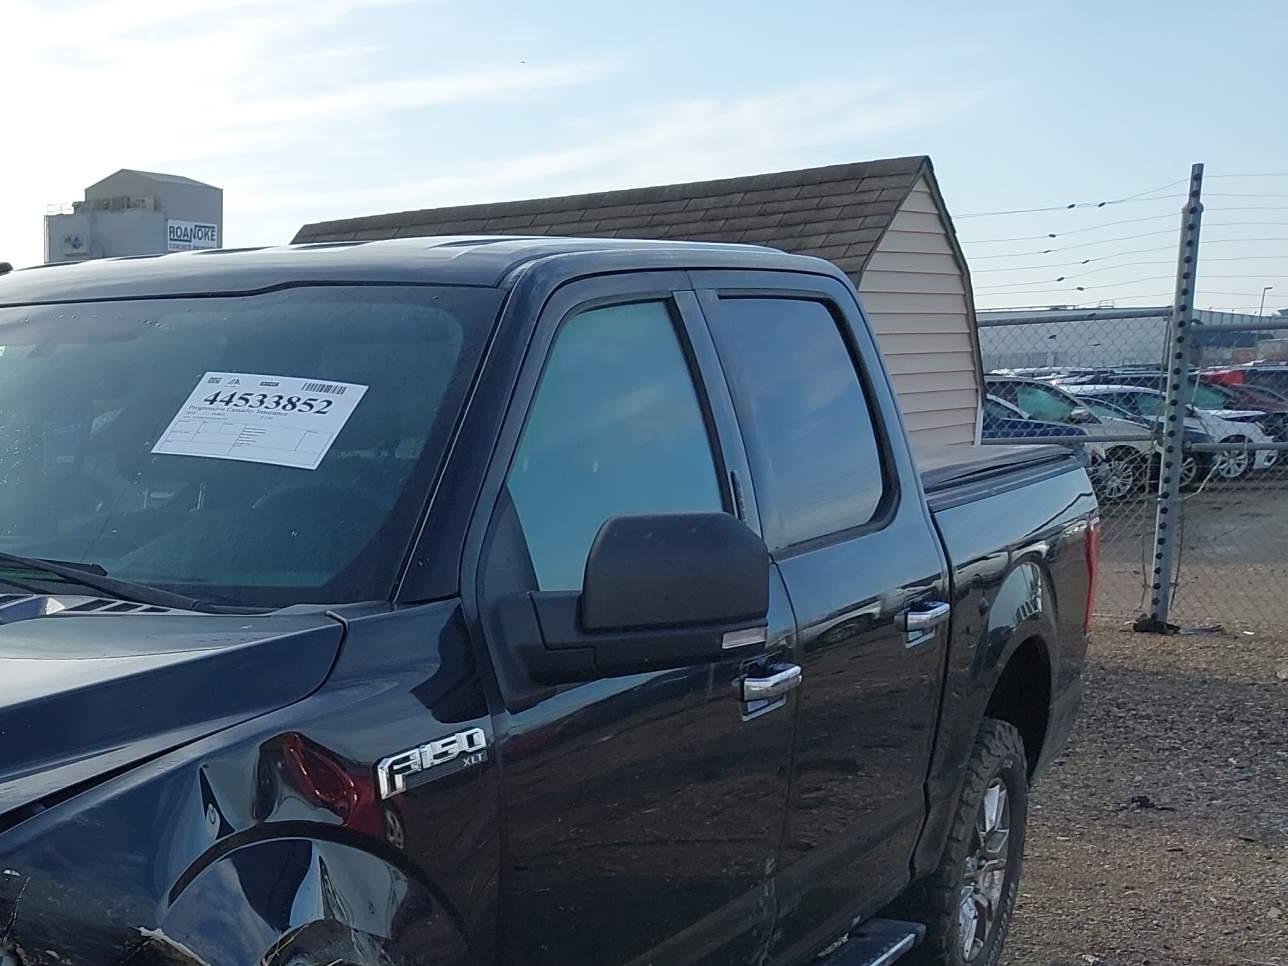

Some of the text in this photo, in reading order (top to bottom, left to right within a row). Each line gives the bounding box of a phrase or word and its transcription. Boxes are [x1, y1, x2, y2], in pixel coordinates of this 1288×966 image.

[169, 224, 216, 242] ROANOKE
[203, 390, 333, 415] 44533852
[188, 405, 225, 413] Progressive
[226, 406, 254, 414] Casualty
[256, 409, 289, 417] Insurance
[462, 752, 485, 767] XLT
